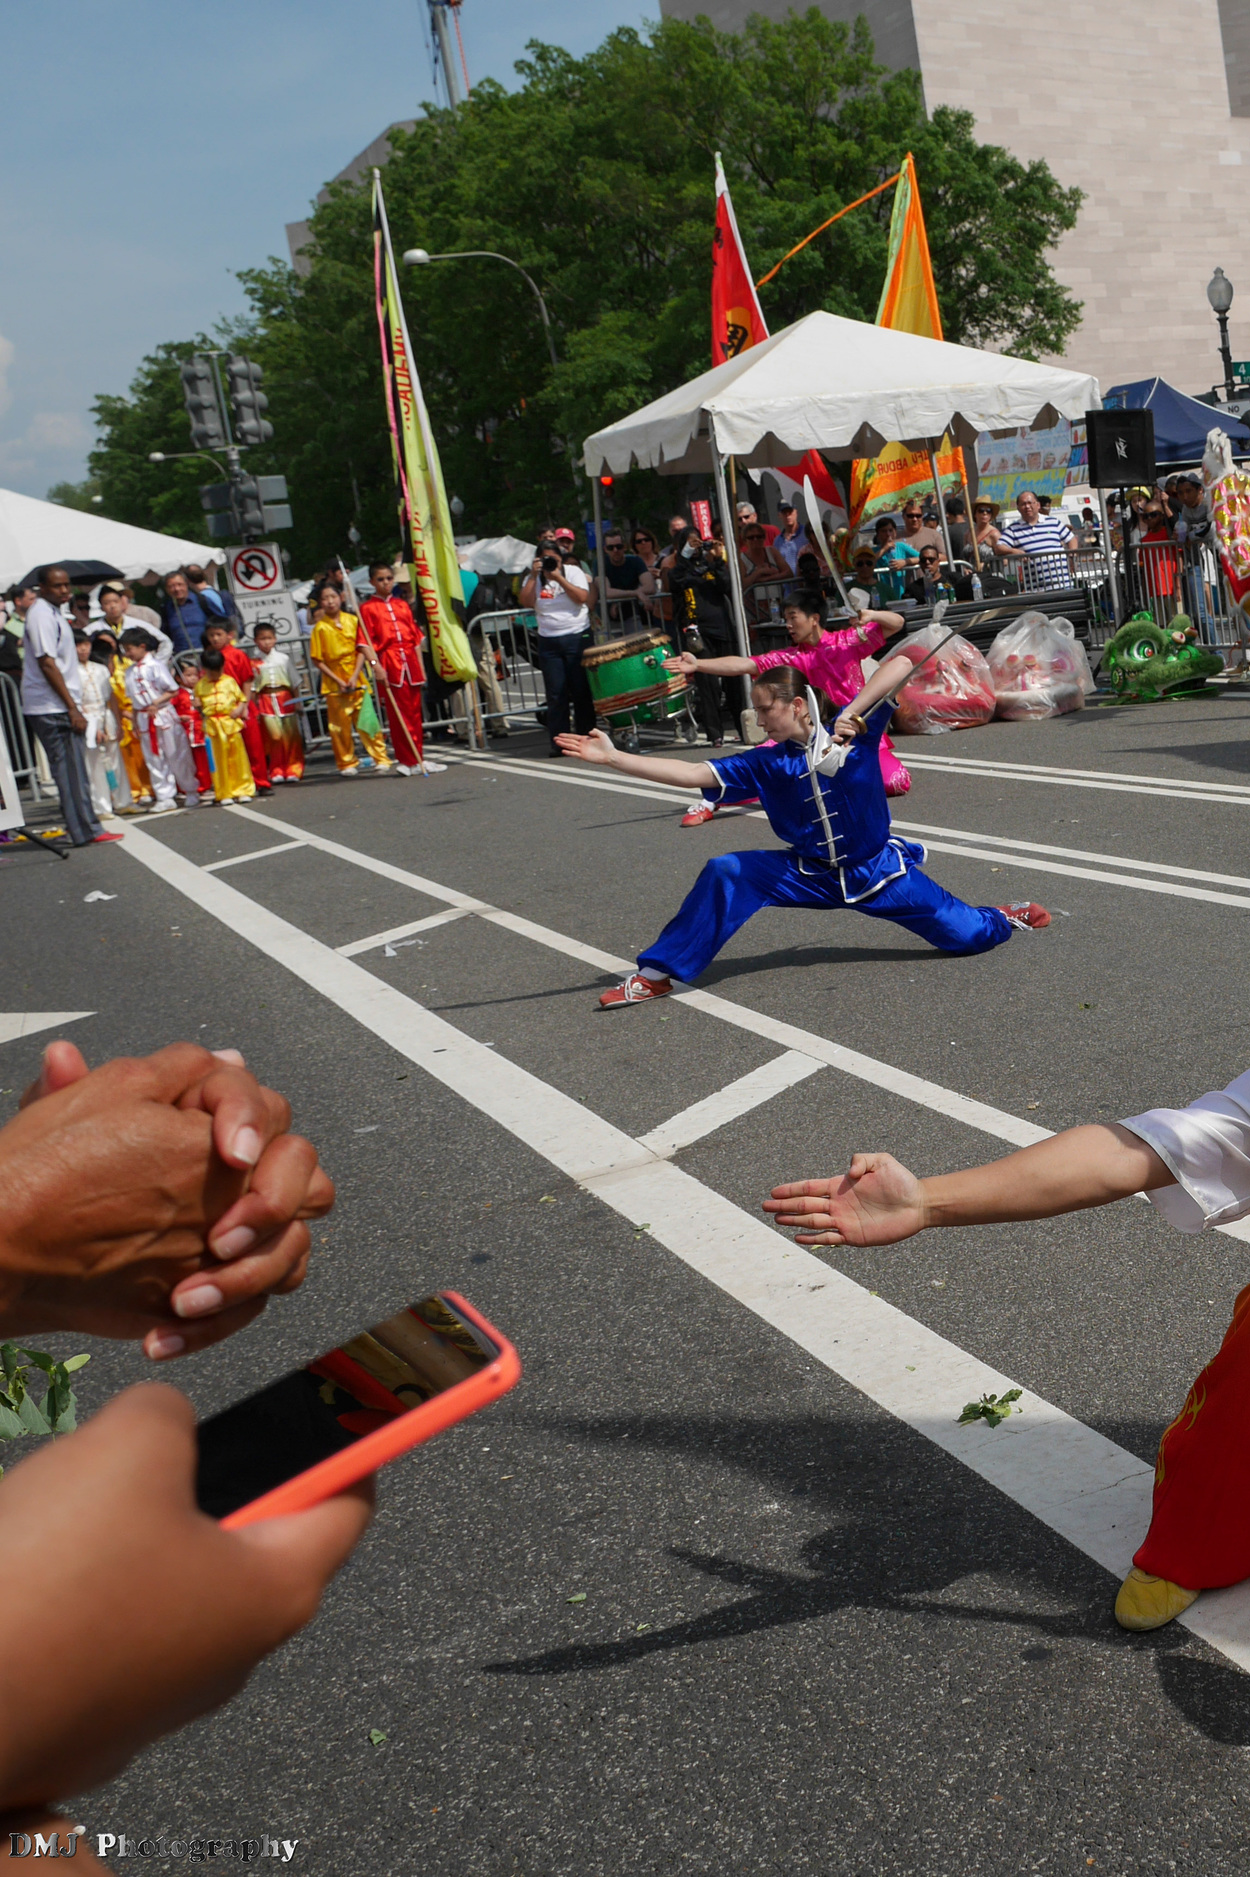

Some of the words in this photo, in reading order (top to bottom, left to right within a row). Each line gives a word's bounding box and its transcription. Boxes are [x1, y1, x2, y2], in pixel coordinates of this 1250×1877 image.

[1238, 363, 1246, 375] 4
[393, 327, 413, 431] CADEMY
[1227, 405, 1240, 414] NO
[699, 503, 712, 538] PRAYER
[241, 597, 284, 609] TURNING
